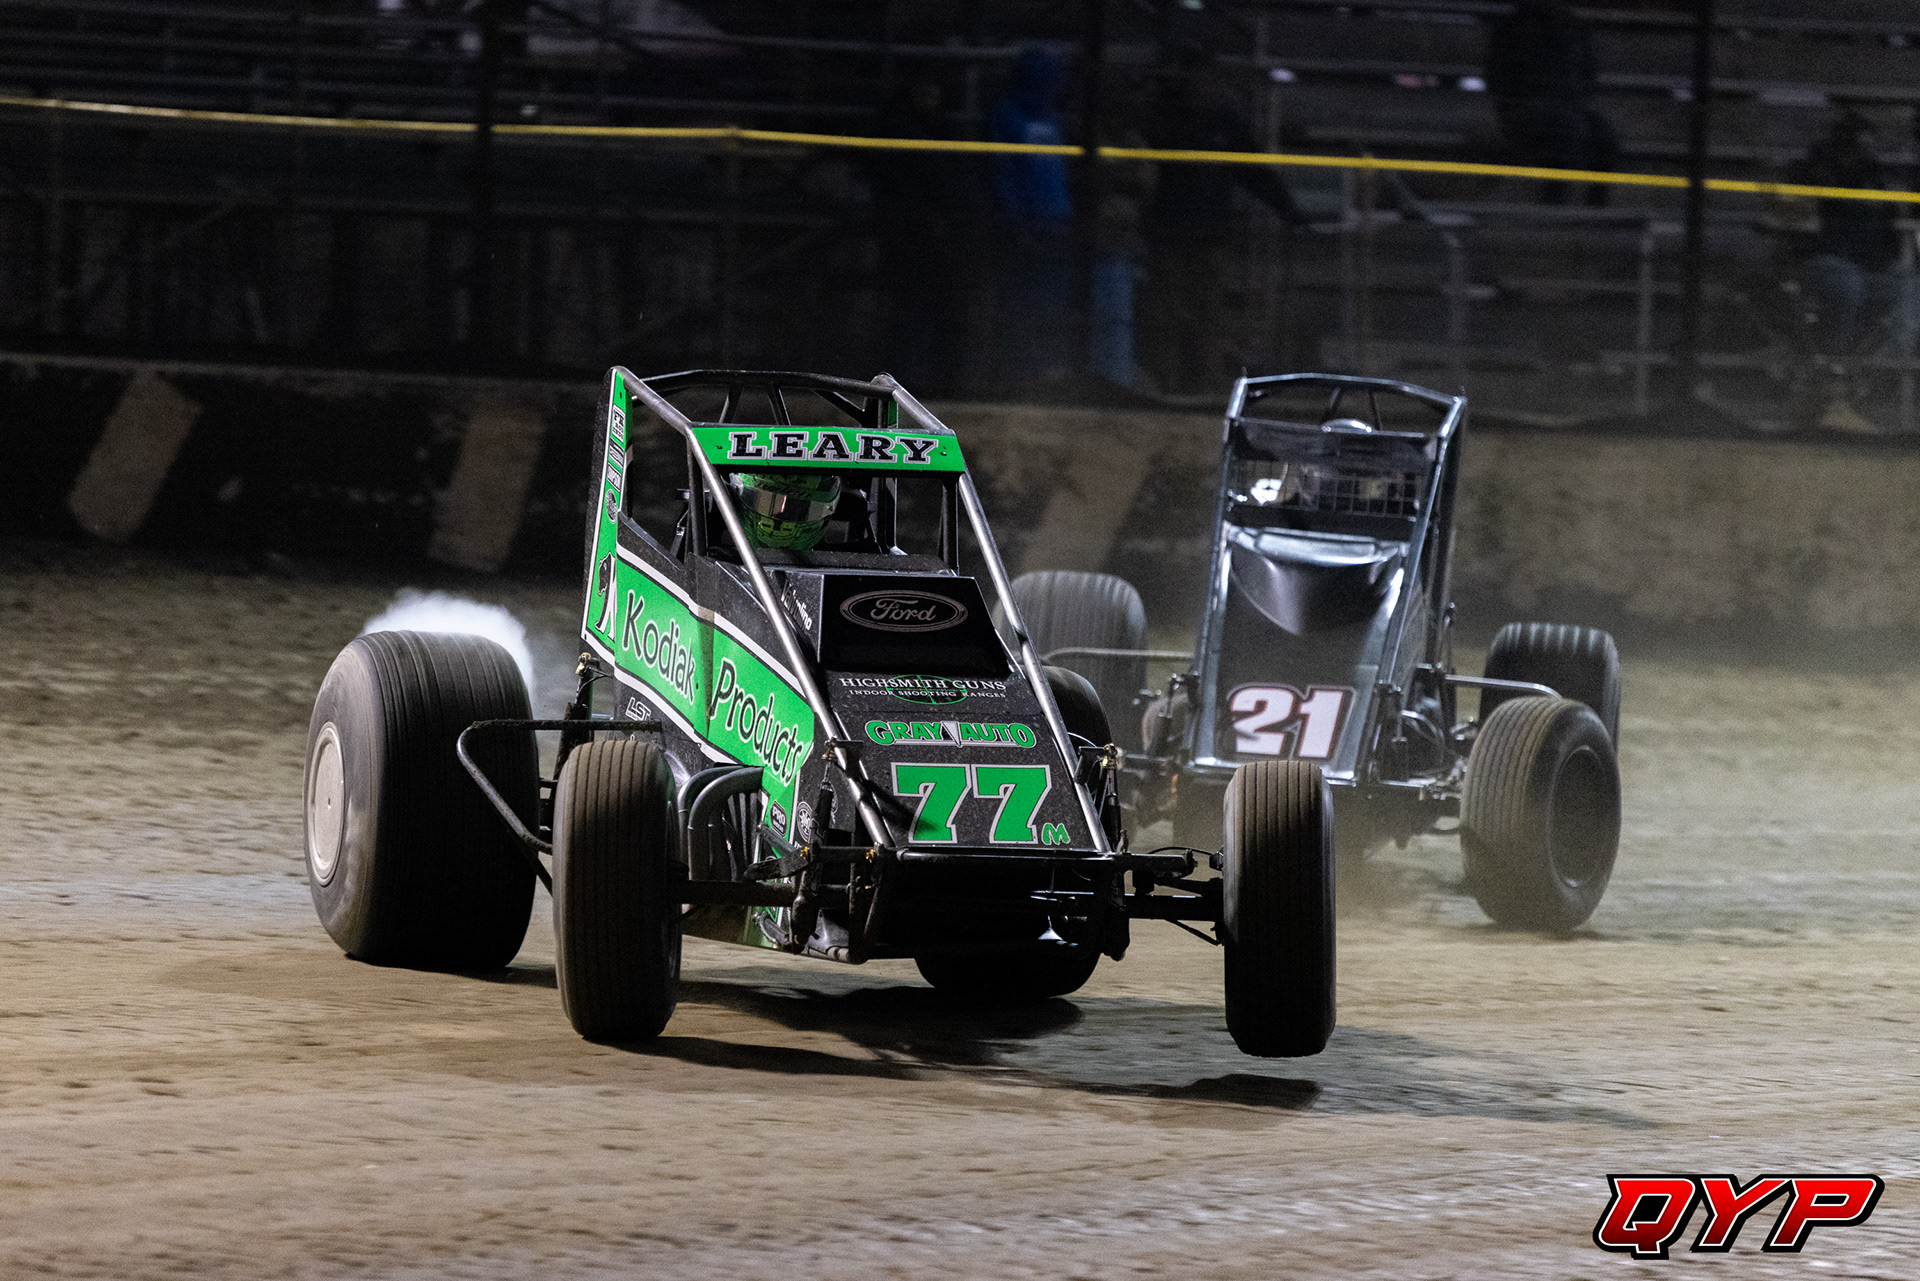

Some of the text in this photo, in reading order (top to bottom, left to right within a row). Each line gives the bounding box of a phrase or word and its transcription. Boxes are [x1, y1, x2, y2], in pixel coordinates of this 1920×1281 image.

[727, 431, 939, 464] LEARY
[870, 596, 937, 622] Ford
[622, 589, 805, 787] Kodiak Products
[839, 677, 1008, 691] HIGHSMITH GUNS
[849, 689, 1007, 699] INDOOR SHOOTING RANGES
[865, 720, 1036, 748] GRAY AUTO
[1229, 684, 1350, 760] 21
